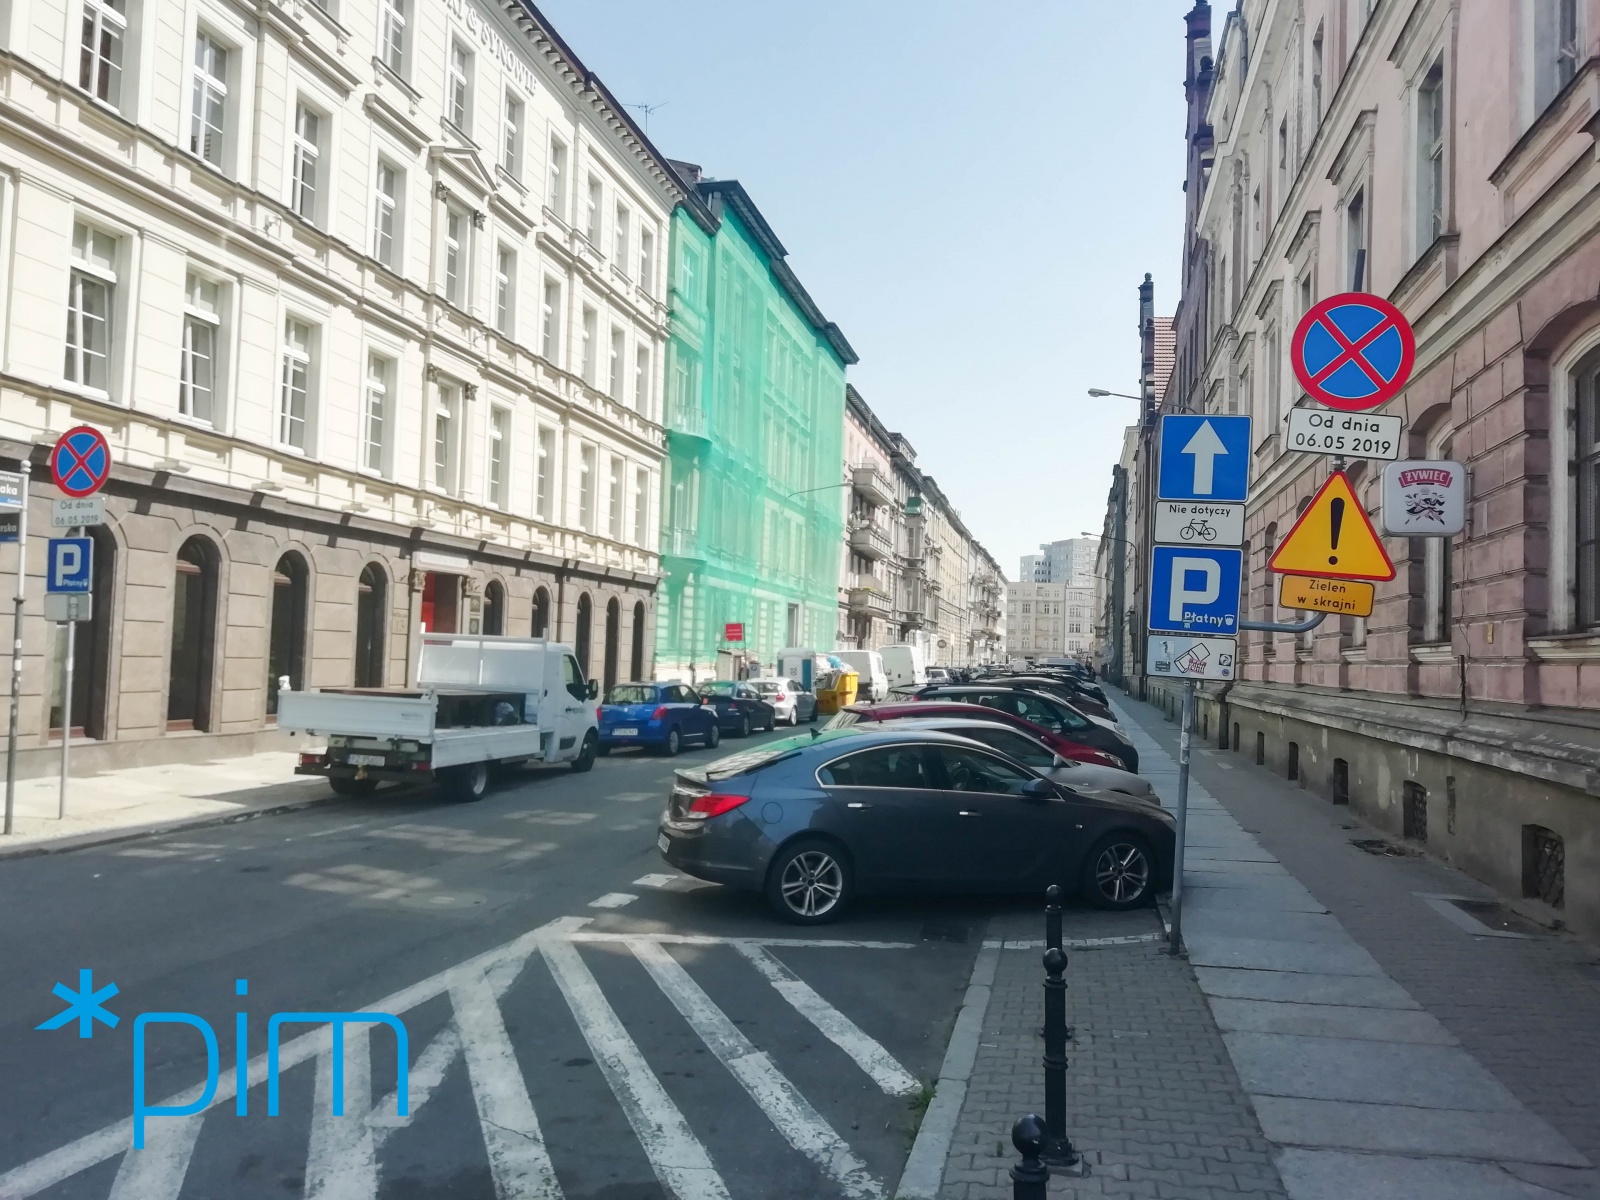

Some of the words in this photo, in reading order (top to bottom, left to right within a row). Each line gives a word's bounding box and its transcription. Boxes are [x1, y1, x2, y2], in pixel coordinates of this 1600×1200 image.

[481, 22, 538, 97] SYNOWIE
[1308, 413, 1334, 429] Od
[1342, 416, 1380, 433] dnia
[1295, 432, 1345, 450] 06.05
[1351, 438, 1391, 455] 2019
[1405, 470, 1447, 482] ŻYWIEC
[0, 484, 18, 496] aka
[60, 501, 72, 510] Od
[75, 501, 94, 509] dnia
[1168, 504, 1188, 515] Nie
[1190, 505, 1232, 518] dotyczy
[81, 514, 99, 524] 2019
[55, 543, 82, 587] P
[1168, 556, 1221, 622] P
[1309, 580, 1346, 594] Zieleń
[1297, 596, 1306, 604] w
[1313, 596, 1357, 611] skrajni
[1184, 611, 1225, 627] Płatny
